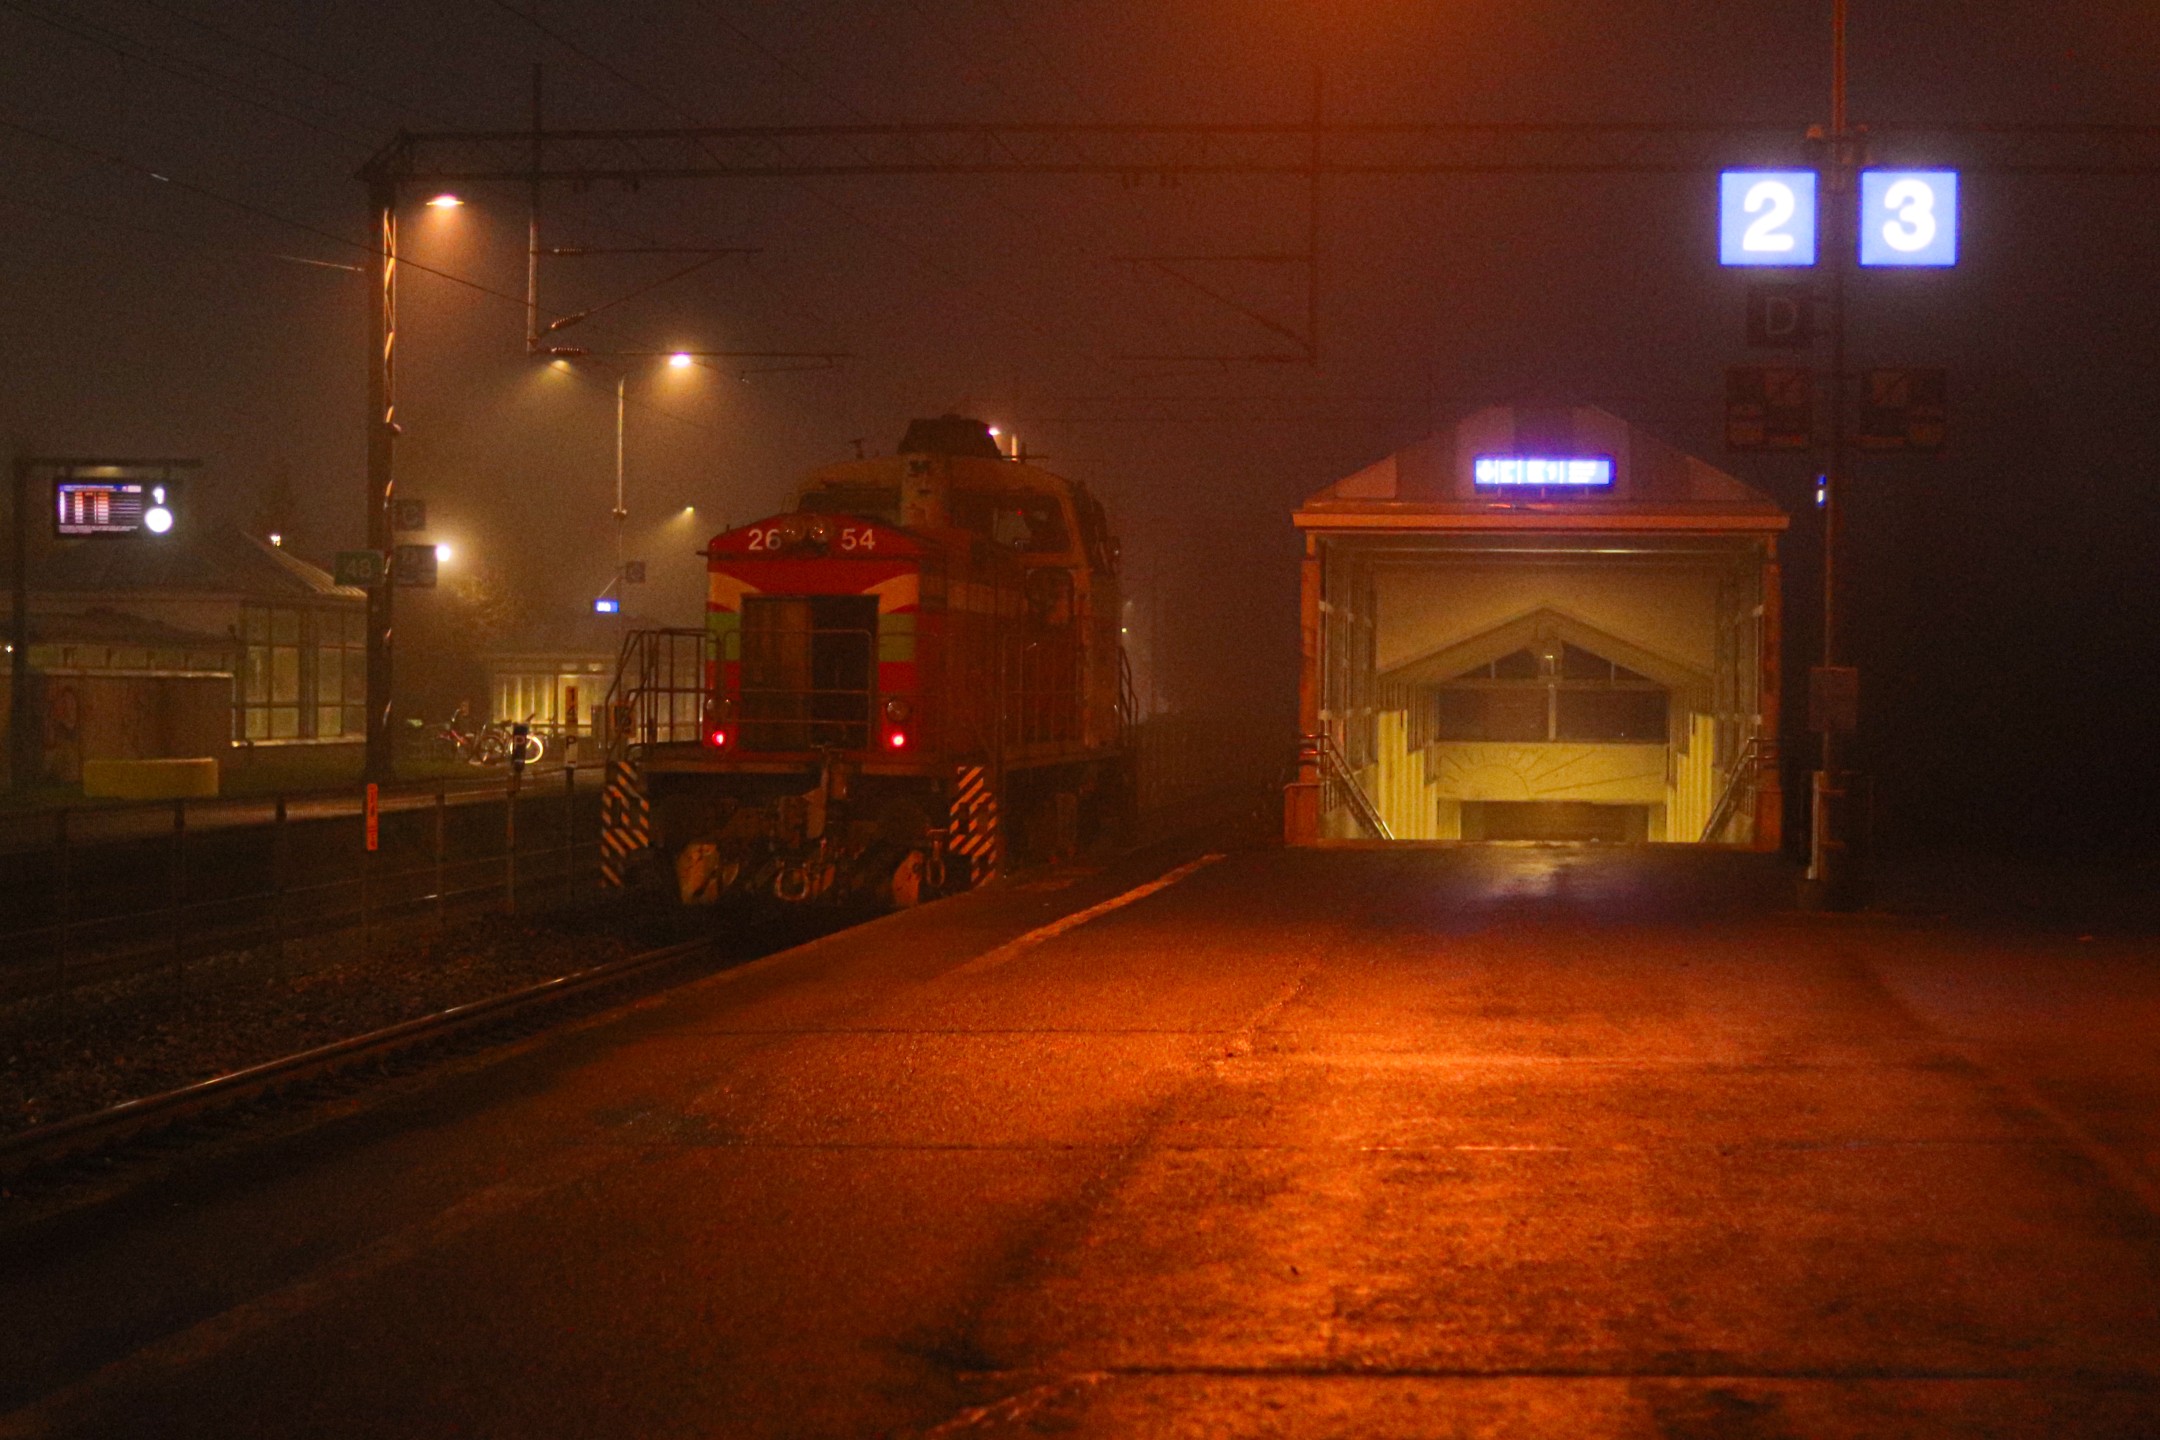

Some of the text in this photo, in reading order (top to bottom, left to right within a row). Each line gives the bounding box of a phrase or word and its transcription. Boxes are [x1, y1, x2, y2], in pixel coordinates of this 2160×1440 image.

[1742, 179, 1795, 252] 2
[1882, 178, 1937, 252] 3
[1765, 295, 1799, 337] D
[748, 528, 876, 550] 26 54
[344, 557, 373, 579] 48
